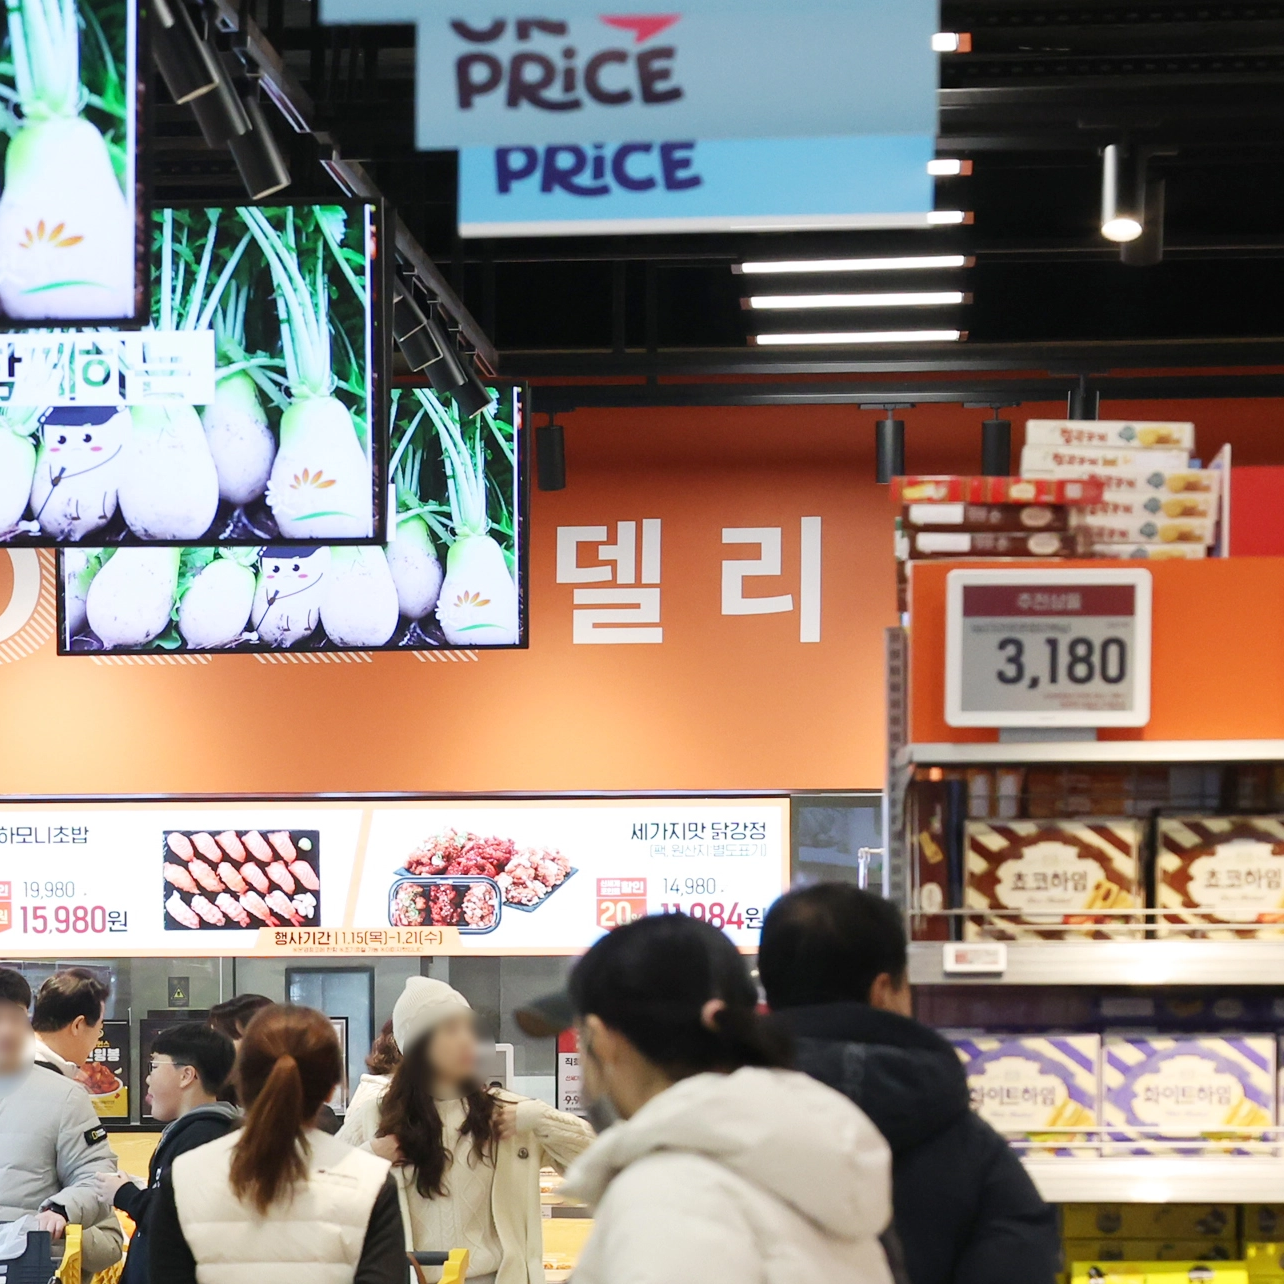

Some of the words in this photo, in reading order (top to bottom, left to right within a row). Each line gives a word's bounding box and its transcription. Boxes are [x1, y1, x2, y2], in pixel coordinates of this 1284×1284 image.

[996, 636, 1127, 689] 3,180
[631, 822, 706, 841] 세가지맛
[711, 822, 766, 841] 닭강정
[23, 881, 75, 900] 19,980
[663, 877, 716, 897] 14,980
[1010, 869, 1089, 893] 초코하임
[1204, 868, 1283, 892] 초코하임
[20, 905, 128, 935] 15,980원
[274, 931, 331, 946] 행사기간
[1142, 1083, 1232, 1107] 화이트하임
